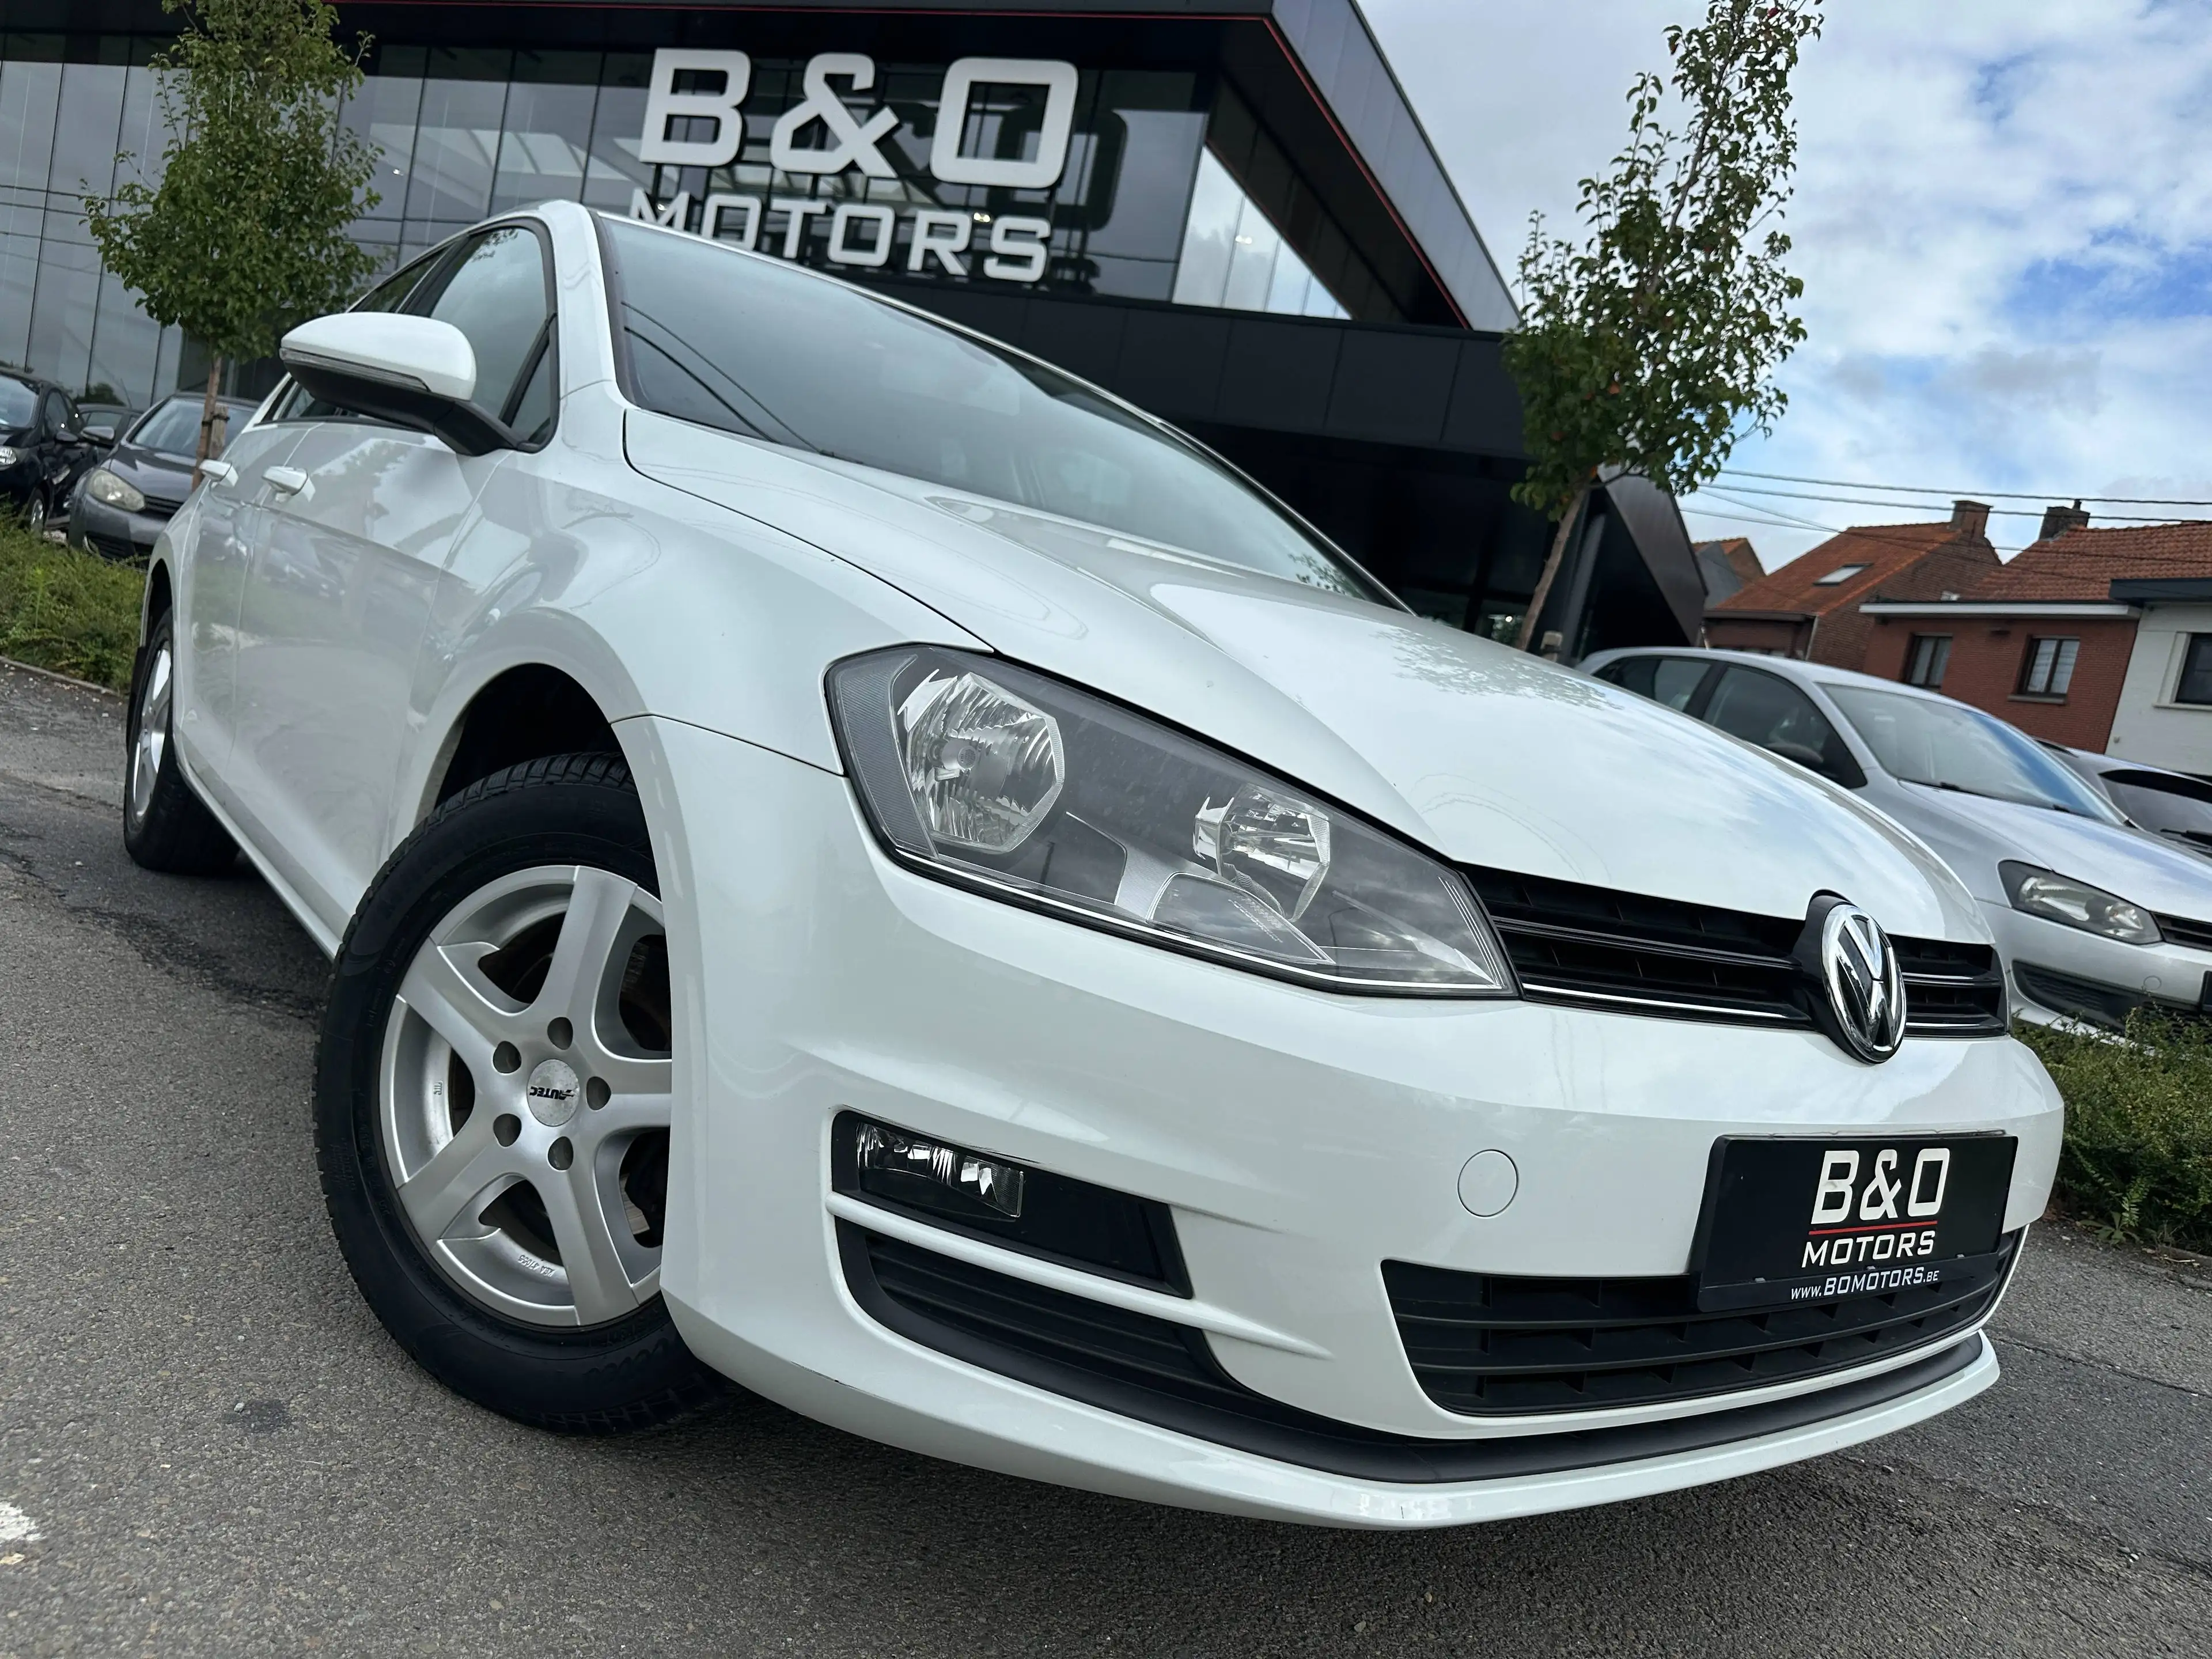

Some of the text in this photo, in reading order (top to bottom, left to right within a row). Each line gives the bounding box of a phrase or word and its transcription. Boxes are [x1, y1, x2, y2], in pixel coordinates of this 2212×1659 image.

[639, 48, 1078, 188] B&O
[629, 187, 1051, 282] MOTORS
[1811, 1148, 1949, 1225] B&O
[1801, 1230, 1936, 1268] MOTORS
